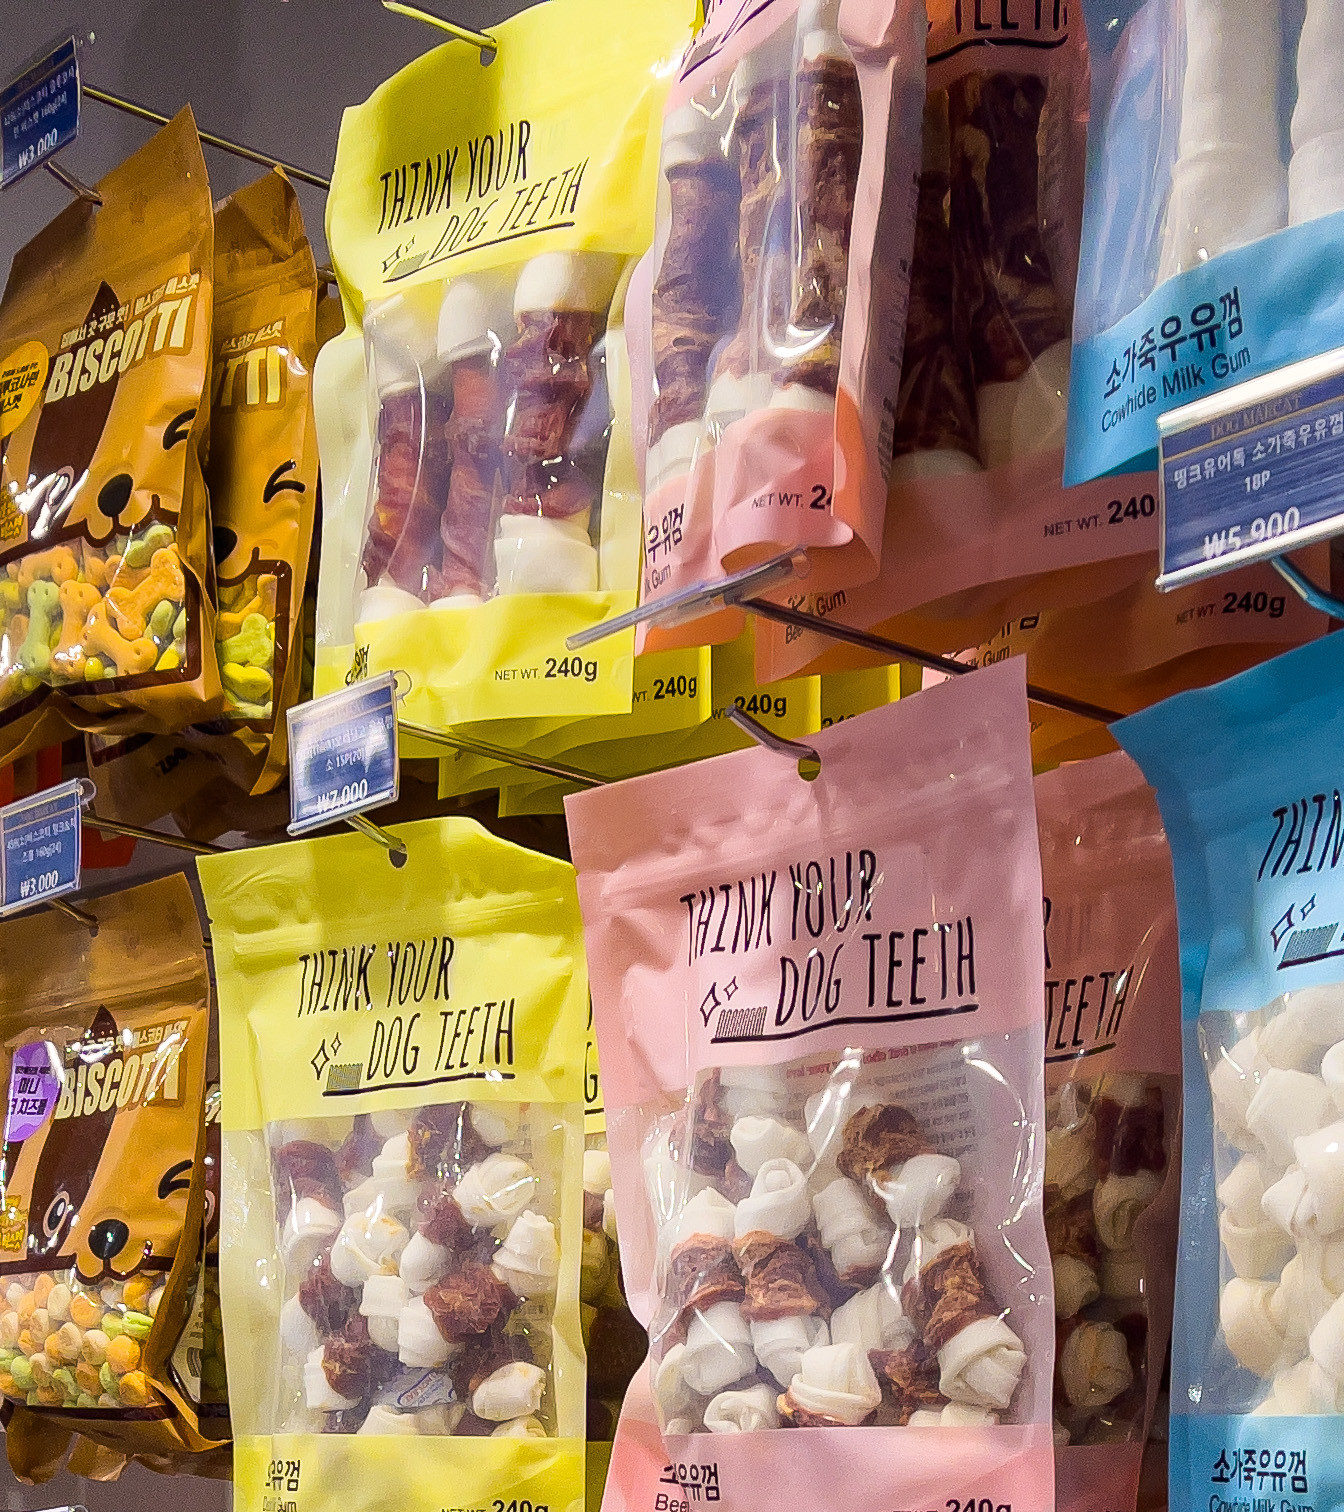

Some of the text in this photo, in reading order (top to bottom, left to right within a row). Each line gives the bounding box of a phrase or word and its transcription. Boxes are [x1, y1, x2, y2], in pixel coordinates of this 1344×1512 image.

[379, 120, 531, 235] THINK YOUR
[430, 158, 589, 262] DOG TEETH
[44, 295, 193, 405] BISCOTTI
[1103, 286, 1244, 400] 소가죽우유껌
[1102, 346, 1251, 433] Cowhide Milk Gum
[1045, 520, 1073, 538] NET
[1107, 495, 1155, 525] 240
[1222, 590, 1286, 619] 240g
[494, 668, 517, 682] NET
[545, 656, 597, 682] 240g
[653, 673, 697, 700] 240g
[733, 692, 786, 716] 240g
[681, 850, 878, 966] THINK YOUR
[298, 936, 455, 1018] THINK YOUR
[775, 916, 976, 1026] DOG TEETH
[366, 998, 515, 1077] DOG TEETH
